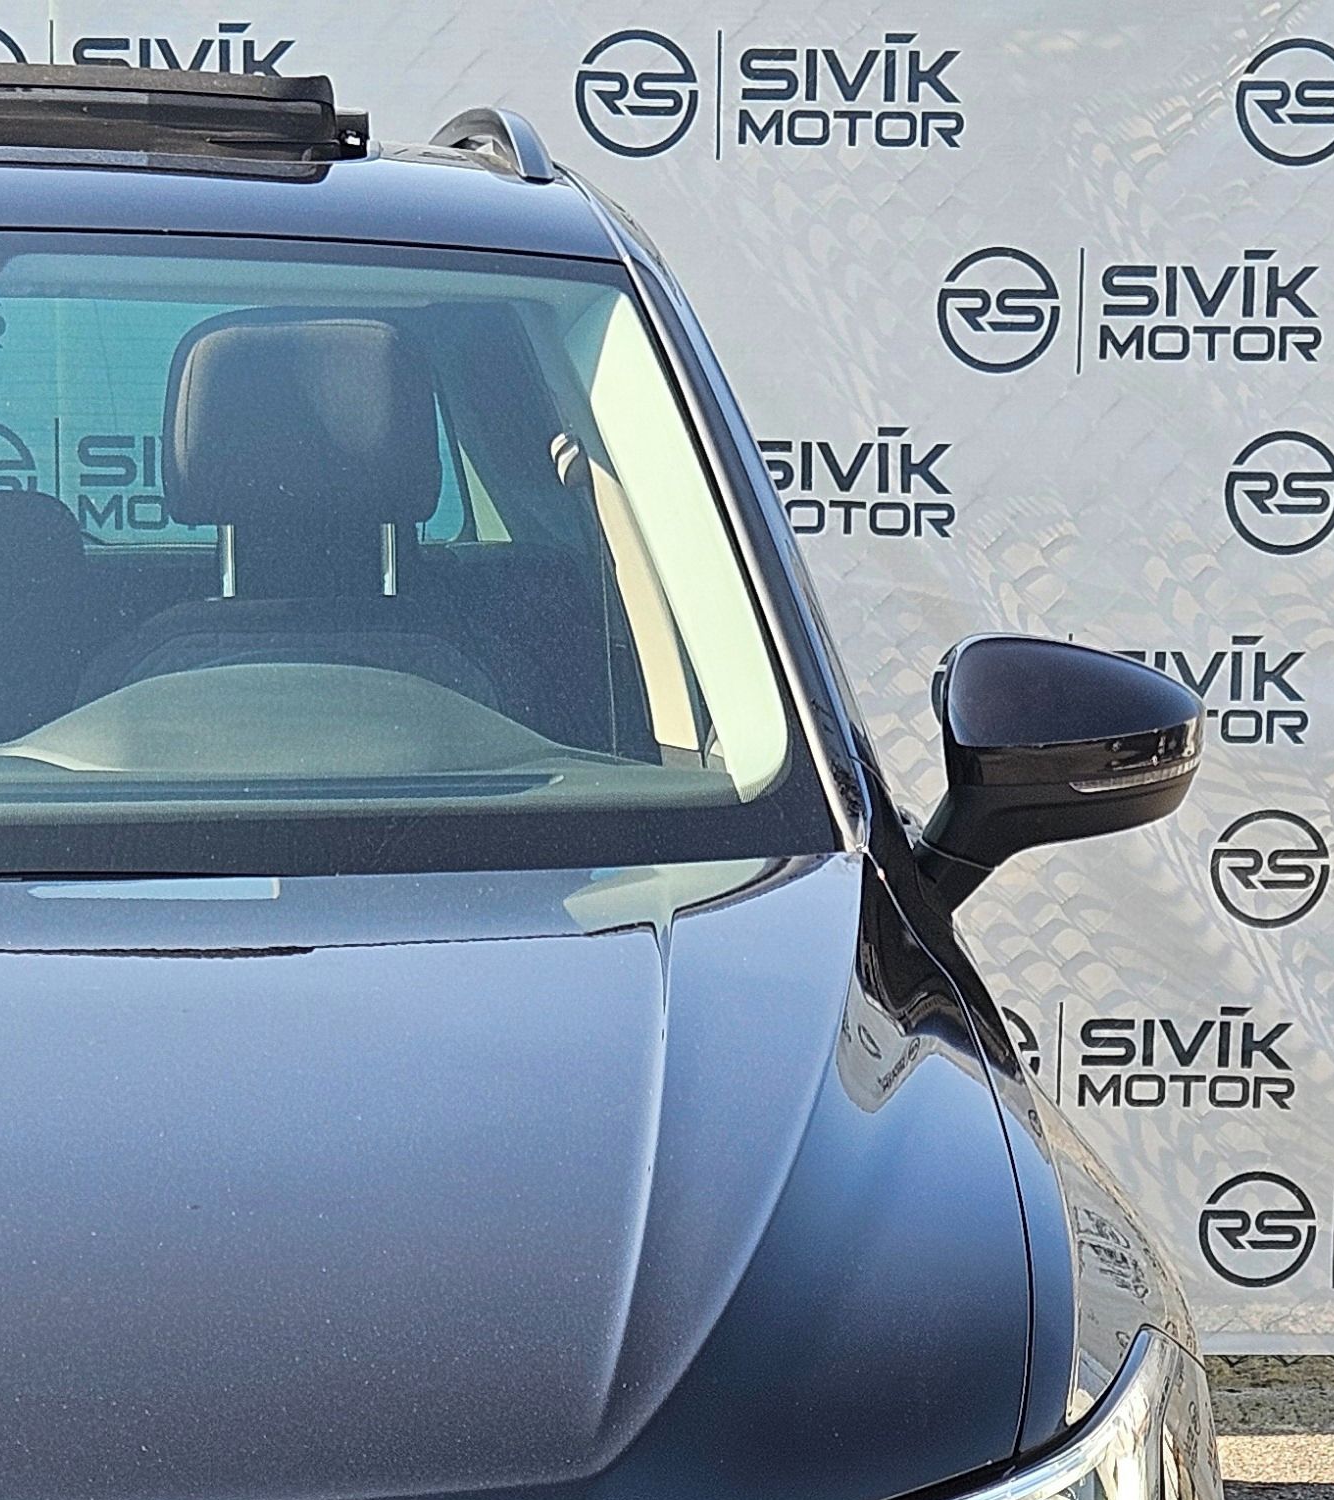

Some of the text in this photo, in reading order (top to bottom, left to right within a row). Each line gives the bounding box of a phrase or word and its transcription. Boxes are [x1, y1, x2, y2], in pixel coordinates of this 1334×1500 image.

[737, 111, 964, 149] MOTOR
[1098, 325, 1322, 362] MOTOR
[784, 500, 956, 538] OTOR
[1114, 635, 1307, 702] VÍK
[1077, 1074, 1295, 1109] MOTOR
